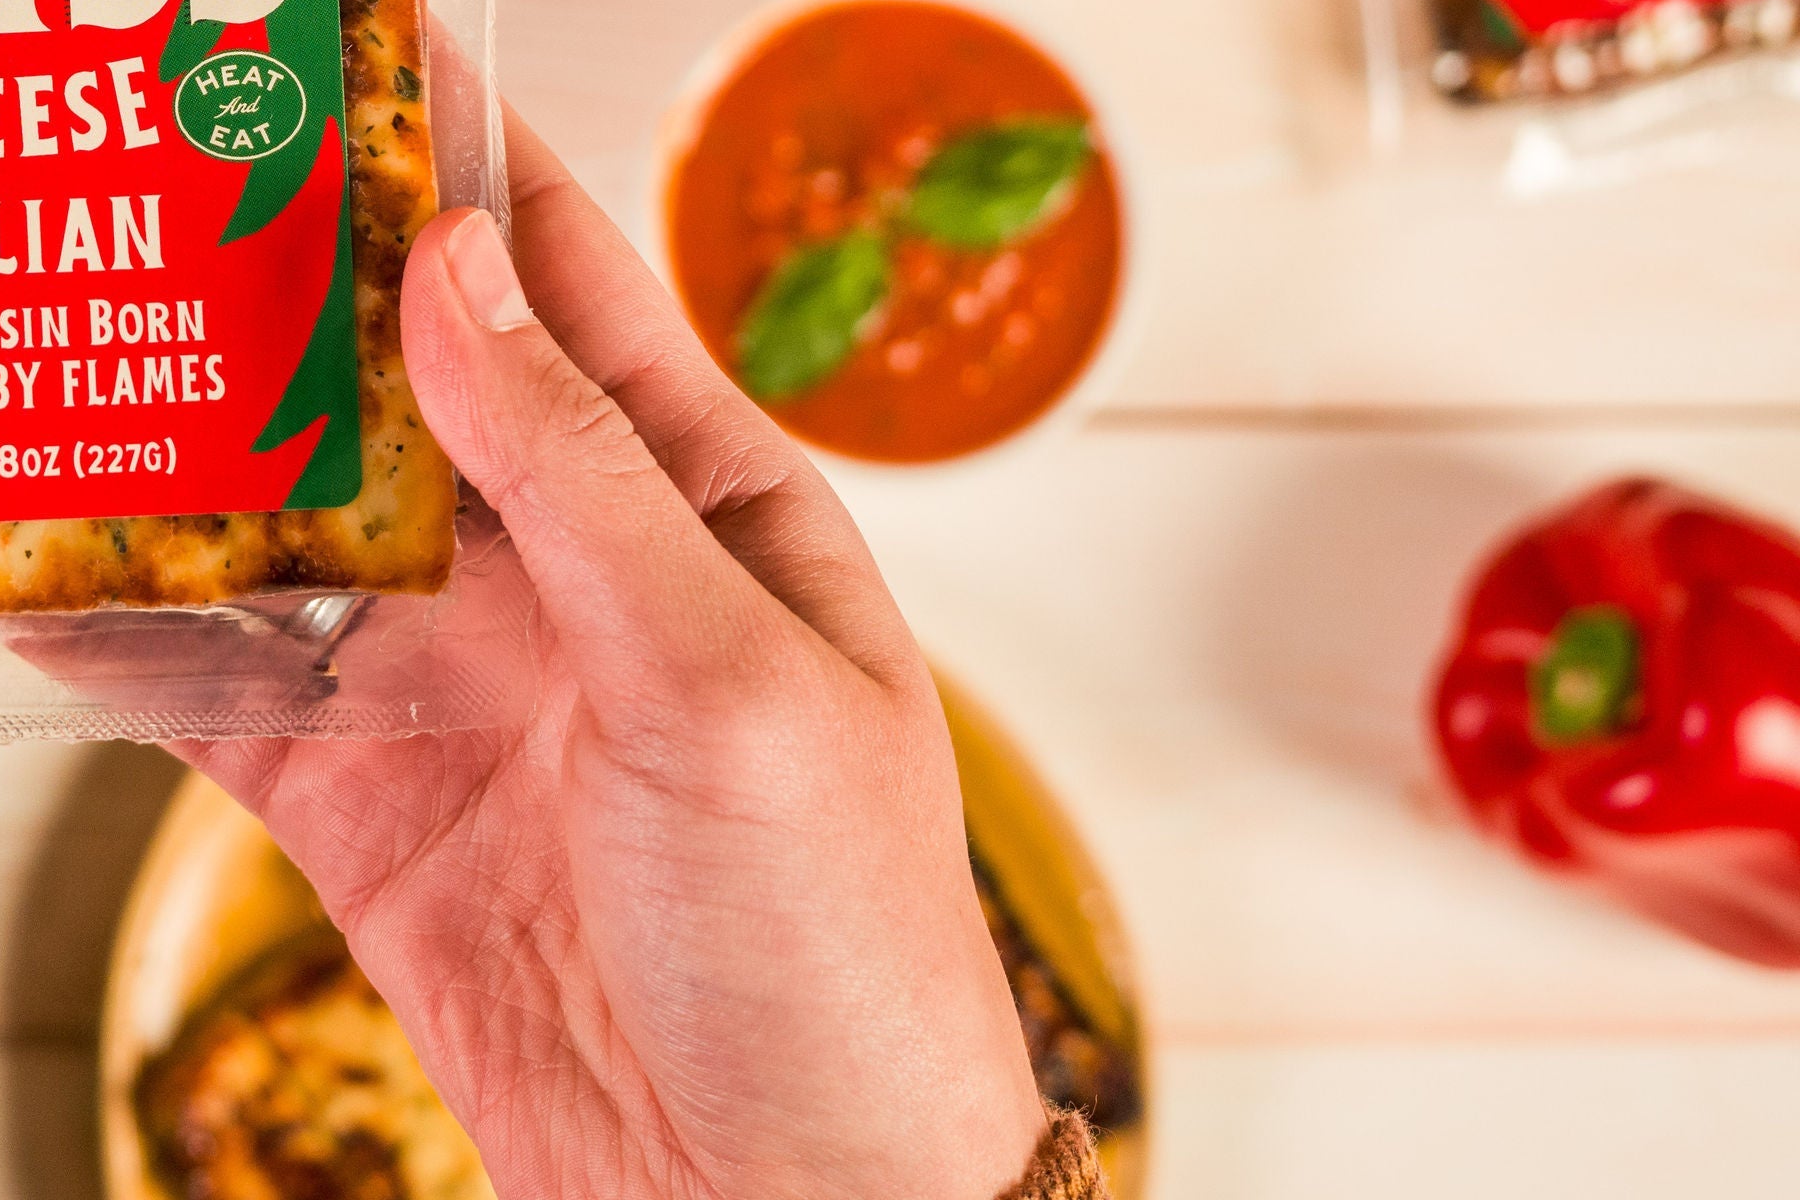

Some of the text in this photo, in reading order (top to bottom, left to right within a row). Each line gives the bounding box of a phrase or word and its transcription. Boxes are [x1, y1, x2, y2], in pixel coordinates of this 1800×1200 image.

[194, 64, 285, 96] HEAT
[213, 95, 262, 119] And
[209, 122, 272, 150] EAT
[88, 299, 206, 346] BORN
[62, 354, 226, 407] FLAMES
[73, 437, 177, 479] (227G)
